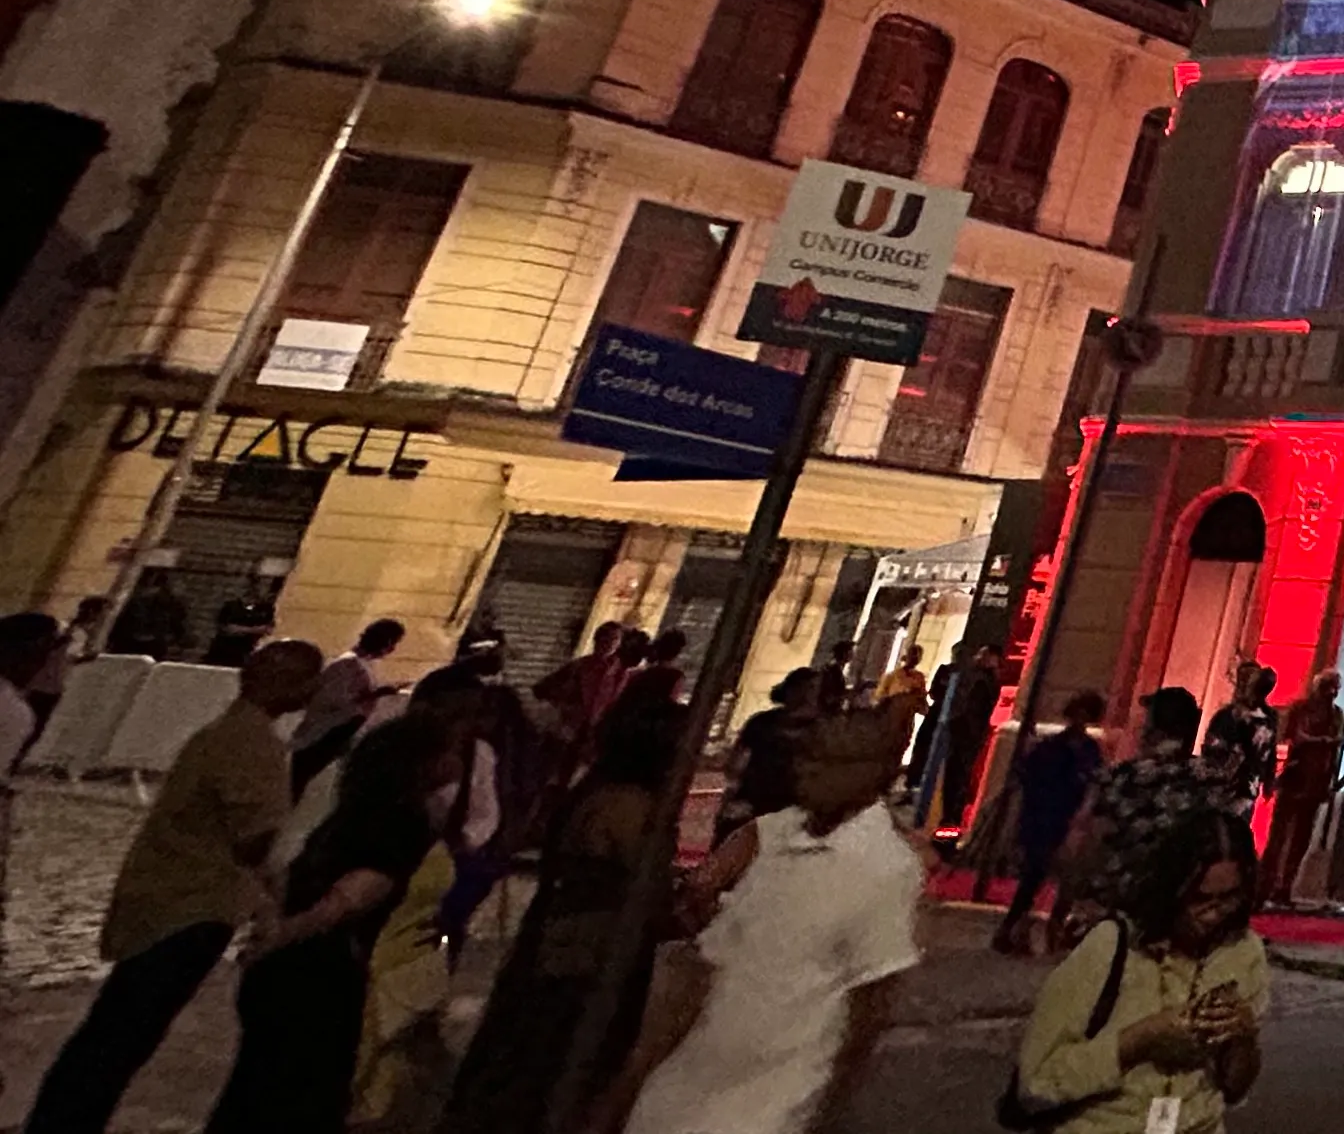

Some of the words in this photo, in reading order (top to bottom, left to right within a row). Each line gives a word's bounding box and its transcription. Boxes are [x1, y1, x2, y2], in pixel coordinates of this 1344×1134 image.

[799, 229, 931, 271] UNIJORGE
[789, 258, 848, 279] Campus
[606, 339, 659, 366] Praça
[595, 368, 661, 398] Conde
[663, 385, 699, 407] dos
[702, 394, 753, 418] Arcos
